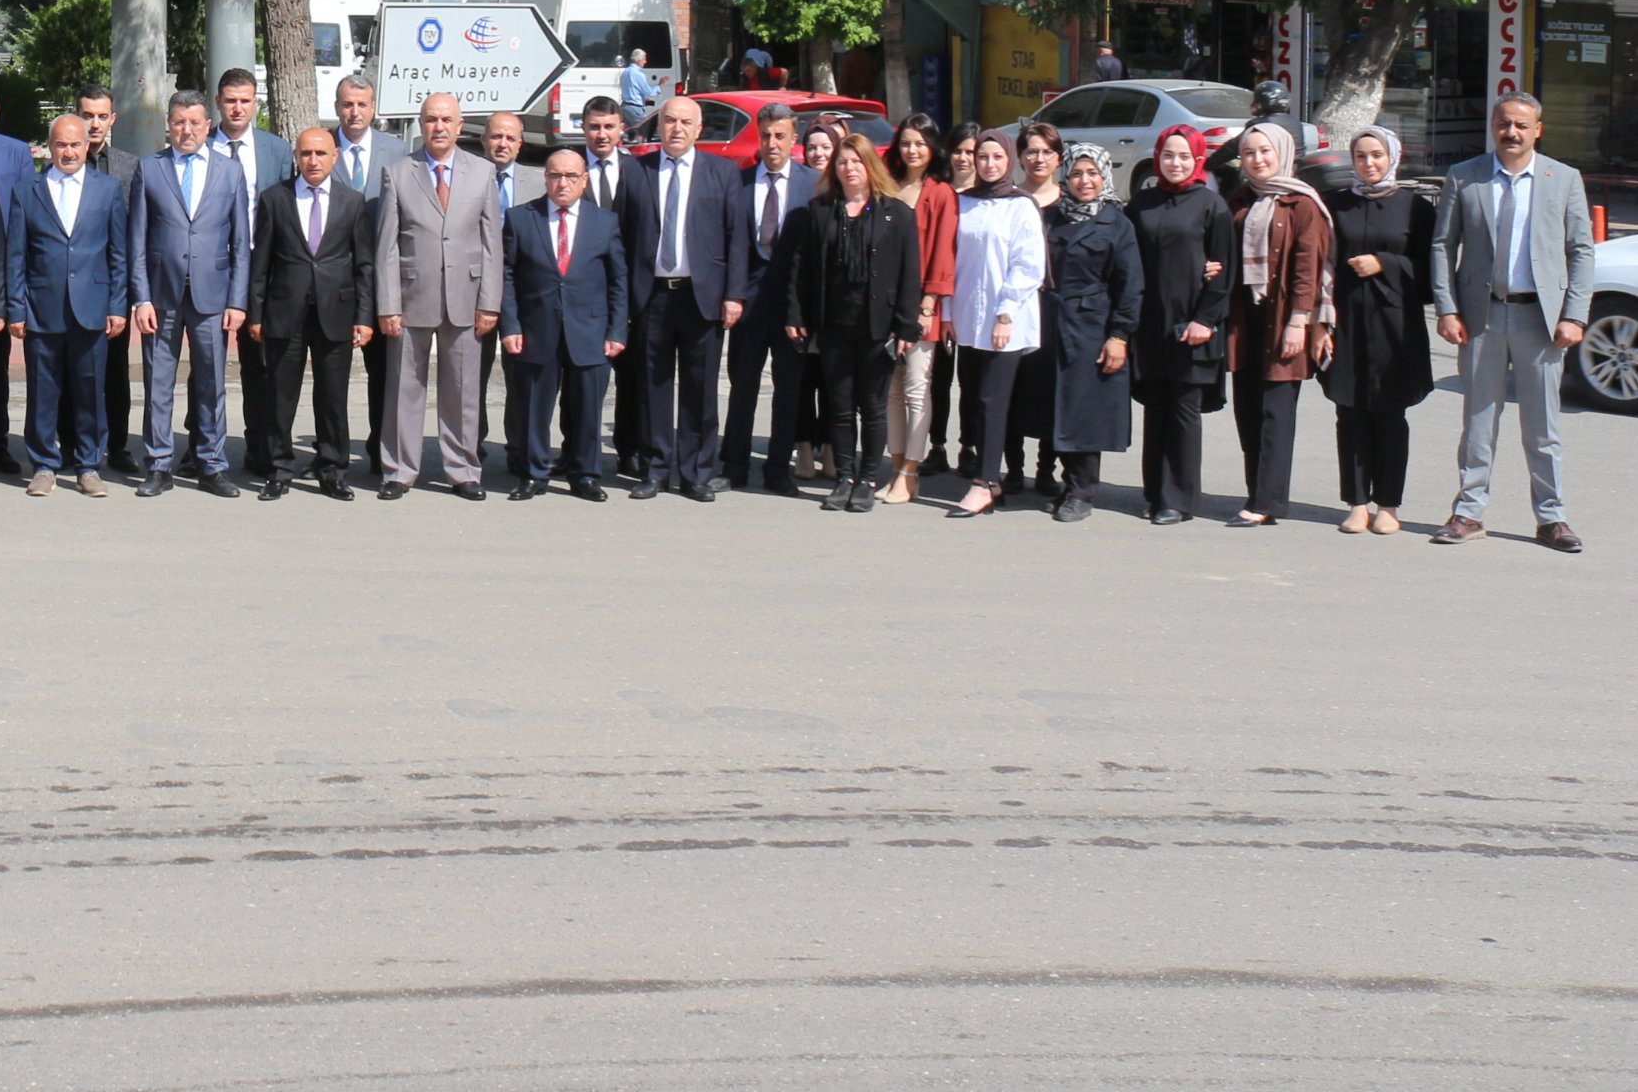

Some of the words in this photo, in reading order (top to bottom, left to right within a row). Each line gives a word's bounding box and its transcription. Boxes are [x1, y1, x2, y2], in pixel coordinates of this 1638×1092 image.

[1011, 50, 1035, 69] STAR
[389, 63, 430, 84] Araç
[441, 63, 521, 82] Muayene
[997, 76, 1024, 97] TEKEL
